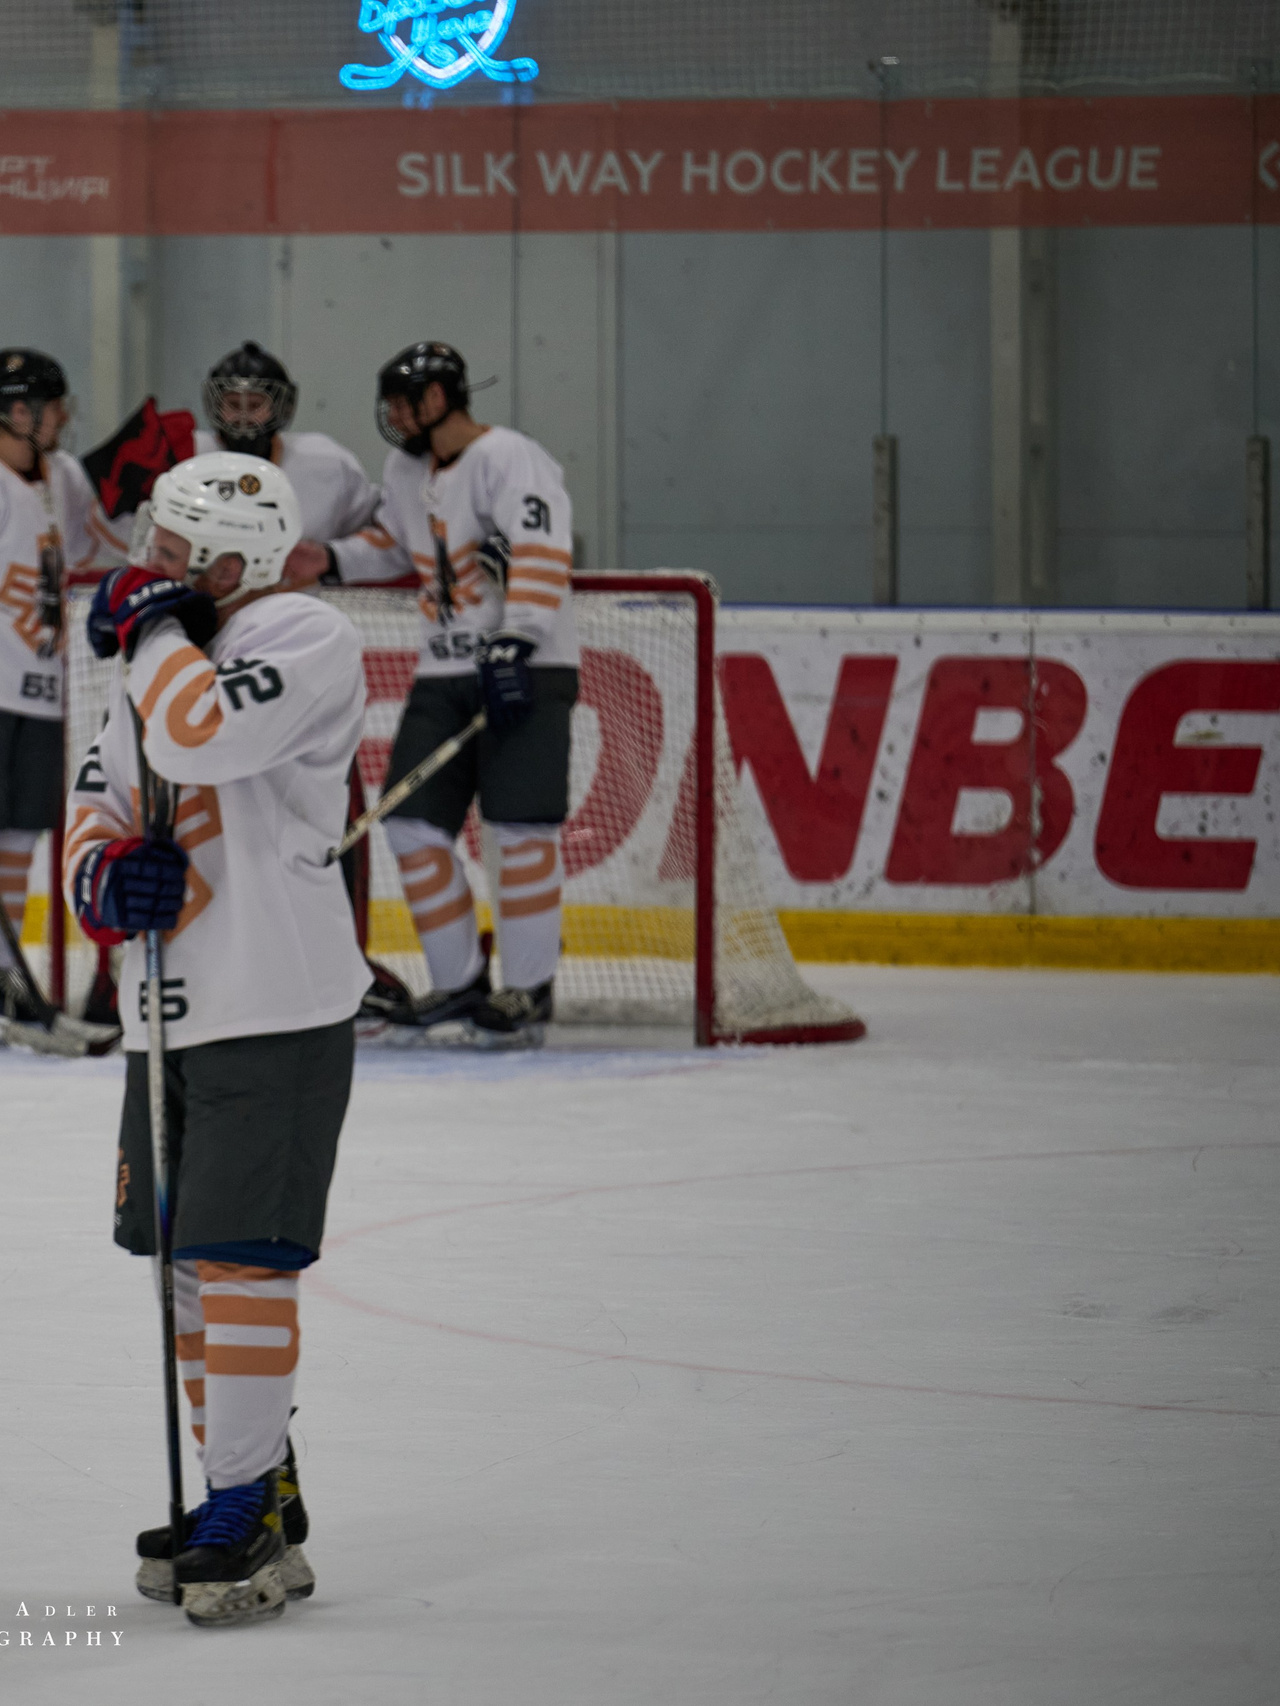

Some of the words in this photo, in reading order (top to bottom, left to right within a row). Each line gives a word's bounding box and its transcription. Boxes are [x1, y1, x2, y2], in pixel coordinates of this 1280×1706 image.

[396, 150, 518, 198] SILK
[536, 149, 664, 196] WAY
[681, 147, 919, 196] HOCKEY
[935, 145, 1162, 193] LEAGUE
